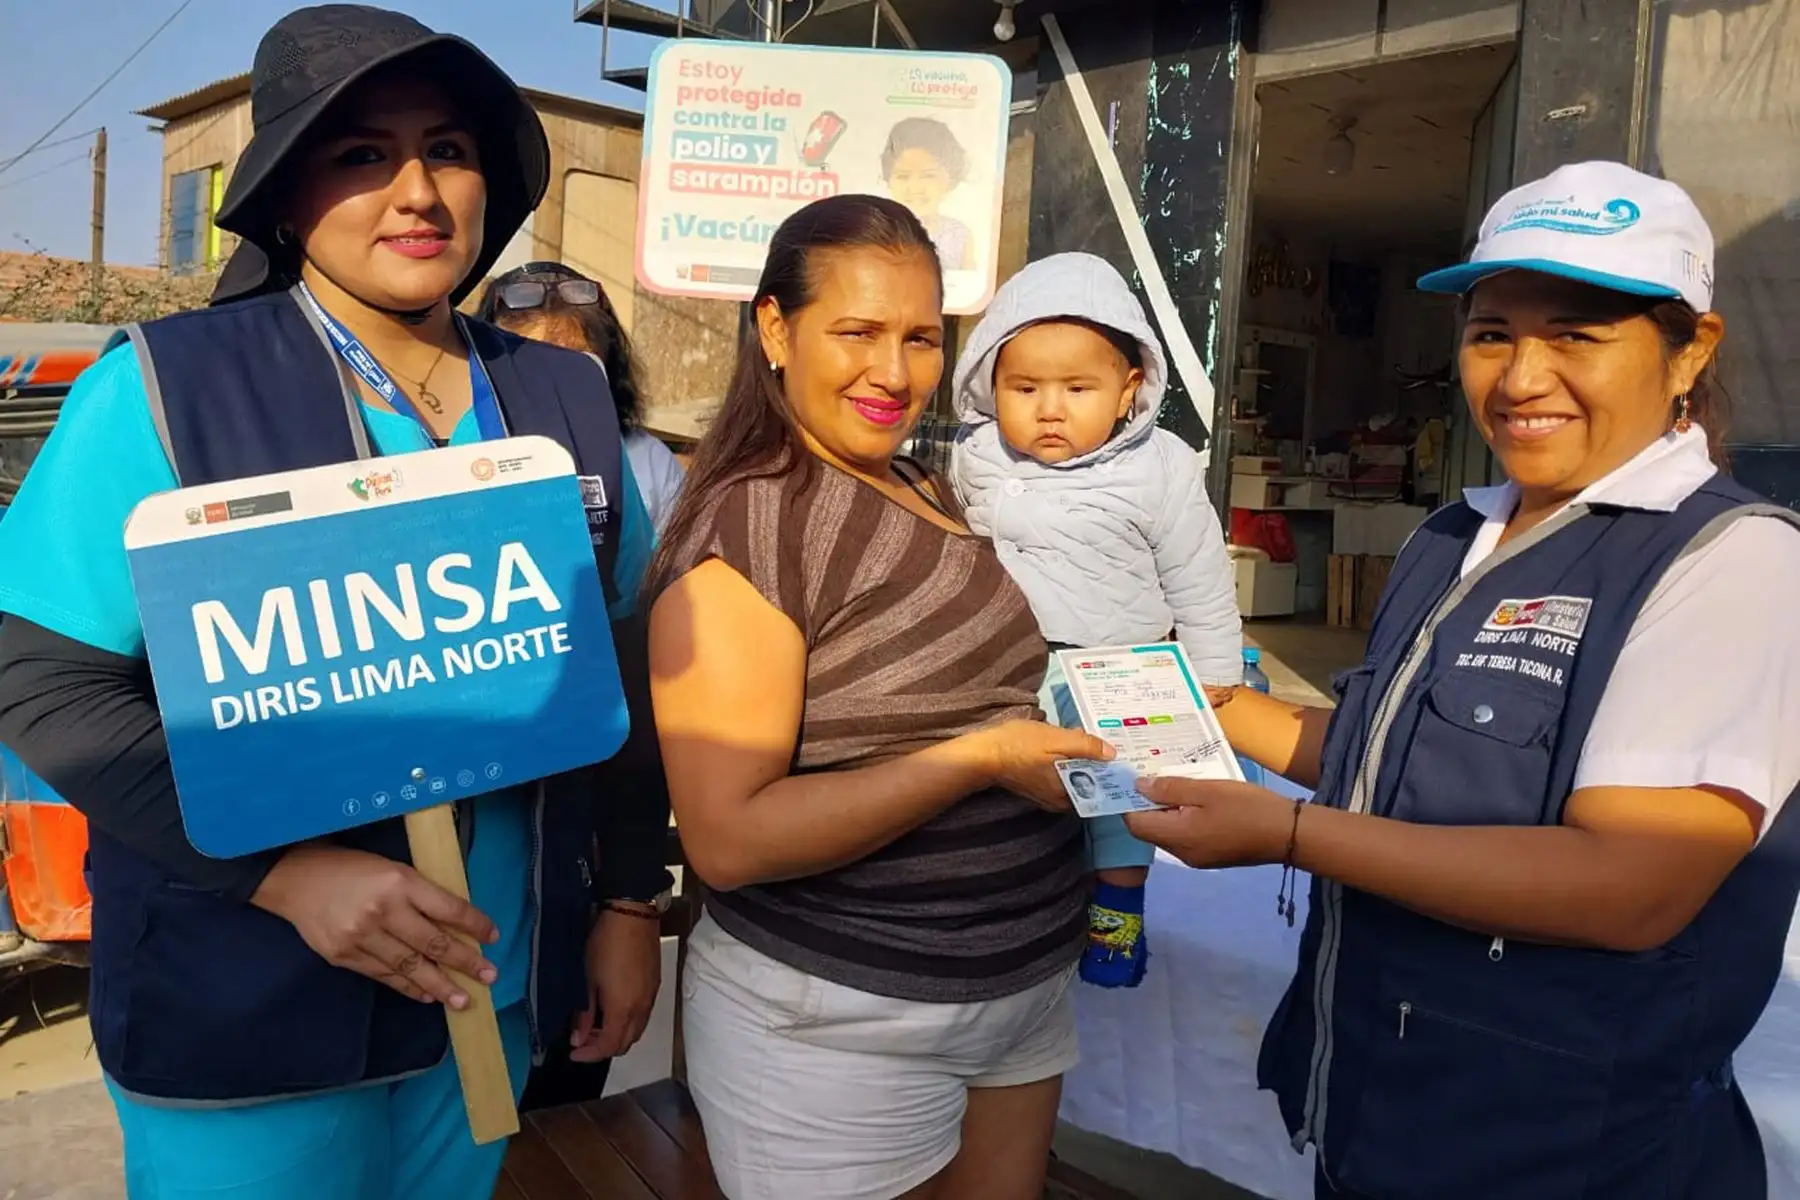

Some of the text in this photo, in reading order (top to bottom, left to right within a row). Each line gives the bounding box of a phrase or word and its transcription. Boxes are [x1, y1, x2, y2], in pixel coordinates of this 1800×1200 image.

[679, 59, 743, 85] Estoy
[677, 85, 802, 111] protegida
[674, 109, 787, 131] contra la
[675, 135, 773, 165] polio y
[672, 168, 835, 199] sarampión
[1541, 206, 1557, 217] mi
[1560, 208, 1600, 221] salud
[192, 542, 562, 684] MINSA
[1474, 631, 1579, 656] DIRIS LIMA NORTE
[211, 622, 573, 731] DIRIS LIMA NORTE
[1487, 653, 1517, 671] TERESA
[1518, 658, 1552, 683] TICONA
